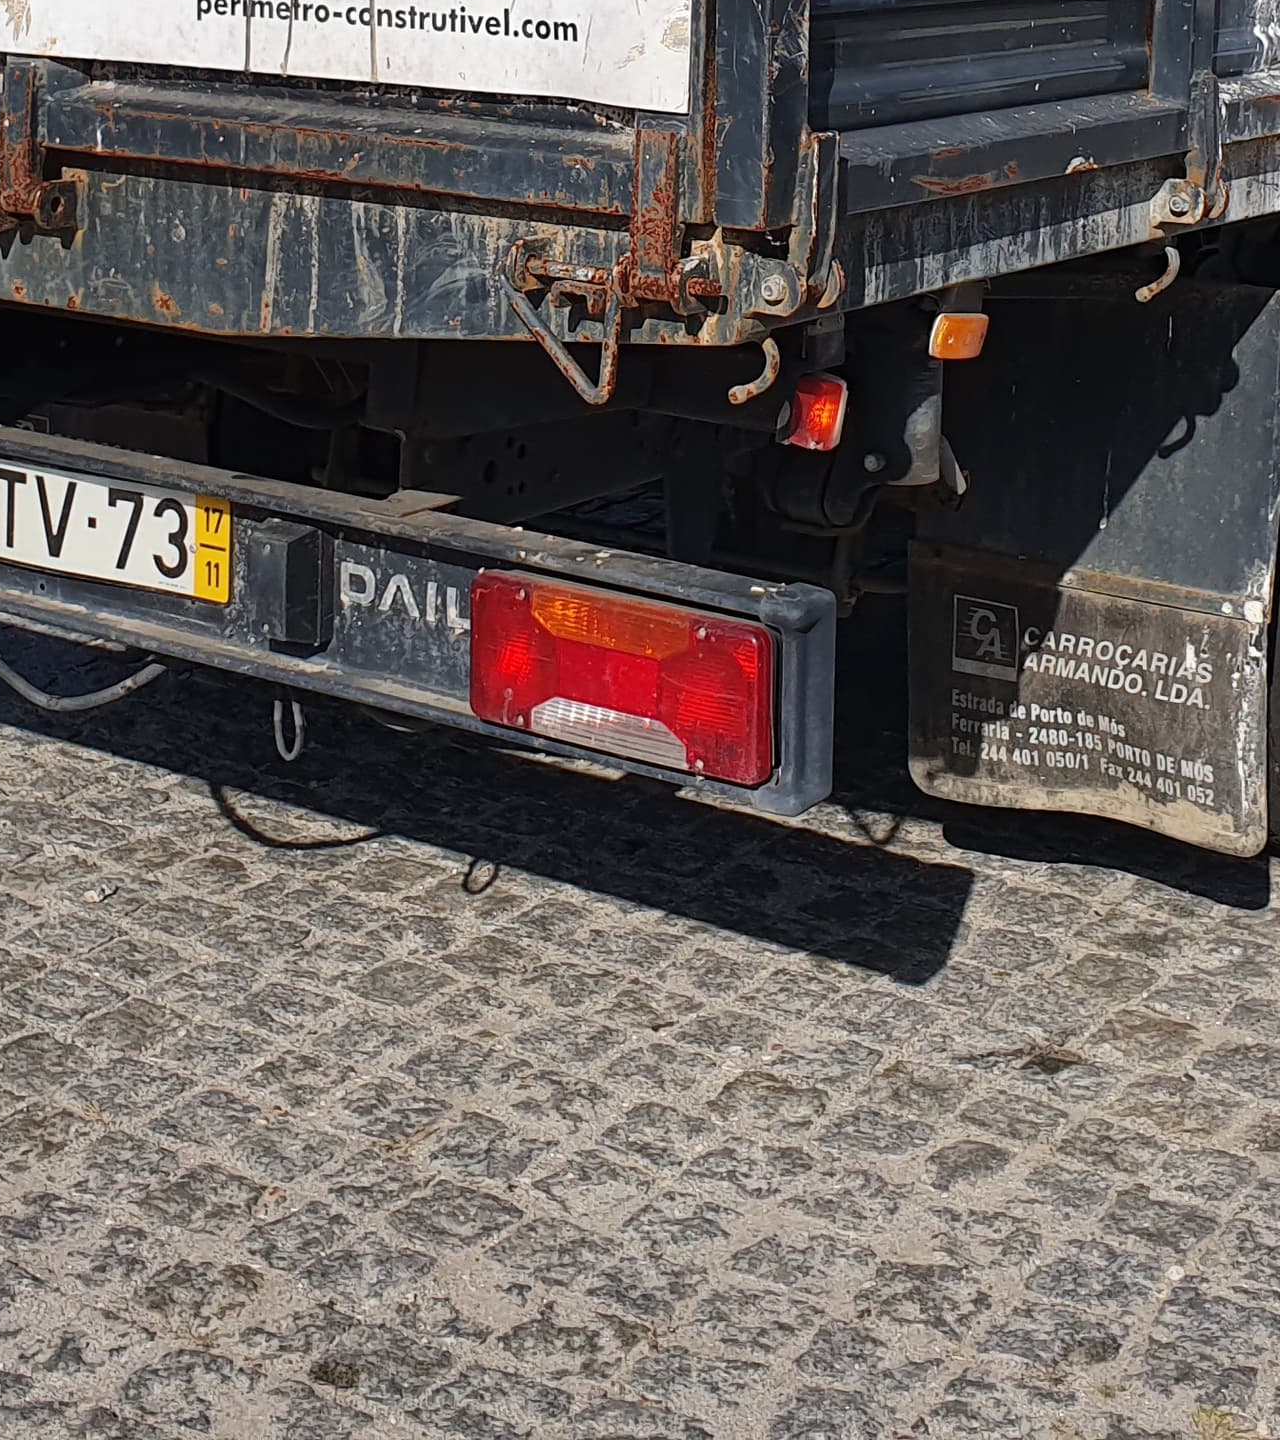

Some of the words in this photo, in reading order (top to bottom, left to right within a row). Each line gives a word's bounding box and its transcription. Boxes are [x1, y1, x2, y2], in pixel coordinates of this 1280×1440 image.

[203, 505, 225, 534] 17
[205, 560, 221, 589] 11
[1023, 626, 1213, 685] CARROÇARIAS
[951, 689, 1005, 718] Estrada
[1009, 700, 1026, 720] de
[1030, 703, 1073, 726] Porto
[1077, 711, 1095, 729] de
[1098, 715, 1126, 738] Mós
[1154, 679, 1211, 711] LDA.
[951, 712, 1010, 741] Ferraria
[1028, 726, 1103, 752] 2480-185
[1107, 741, 1152, 768] PORTO
[1156, 755, 1176, 774] DE
[1180, 759, 1215, 784] MÓS
[951, 736, 977, 758] Tel.
[980, 742, 1008, 762] 244
[1012, 748, 1040, 767] 401
[1045, 752, 1090, 770] 050/1
[1099, 757, 1124, 779] Fax
[1126, 766, 1153, 789] 244
[1156, 778, 1182, 799] 401
[1186, 785, 1215, 808] 052
